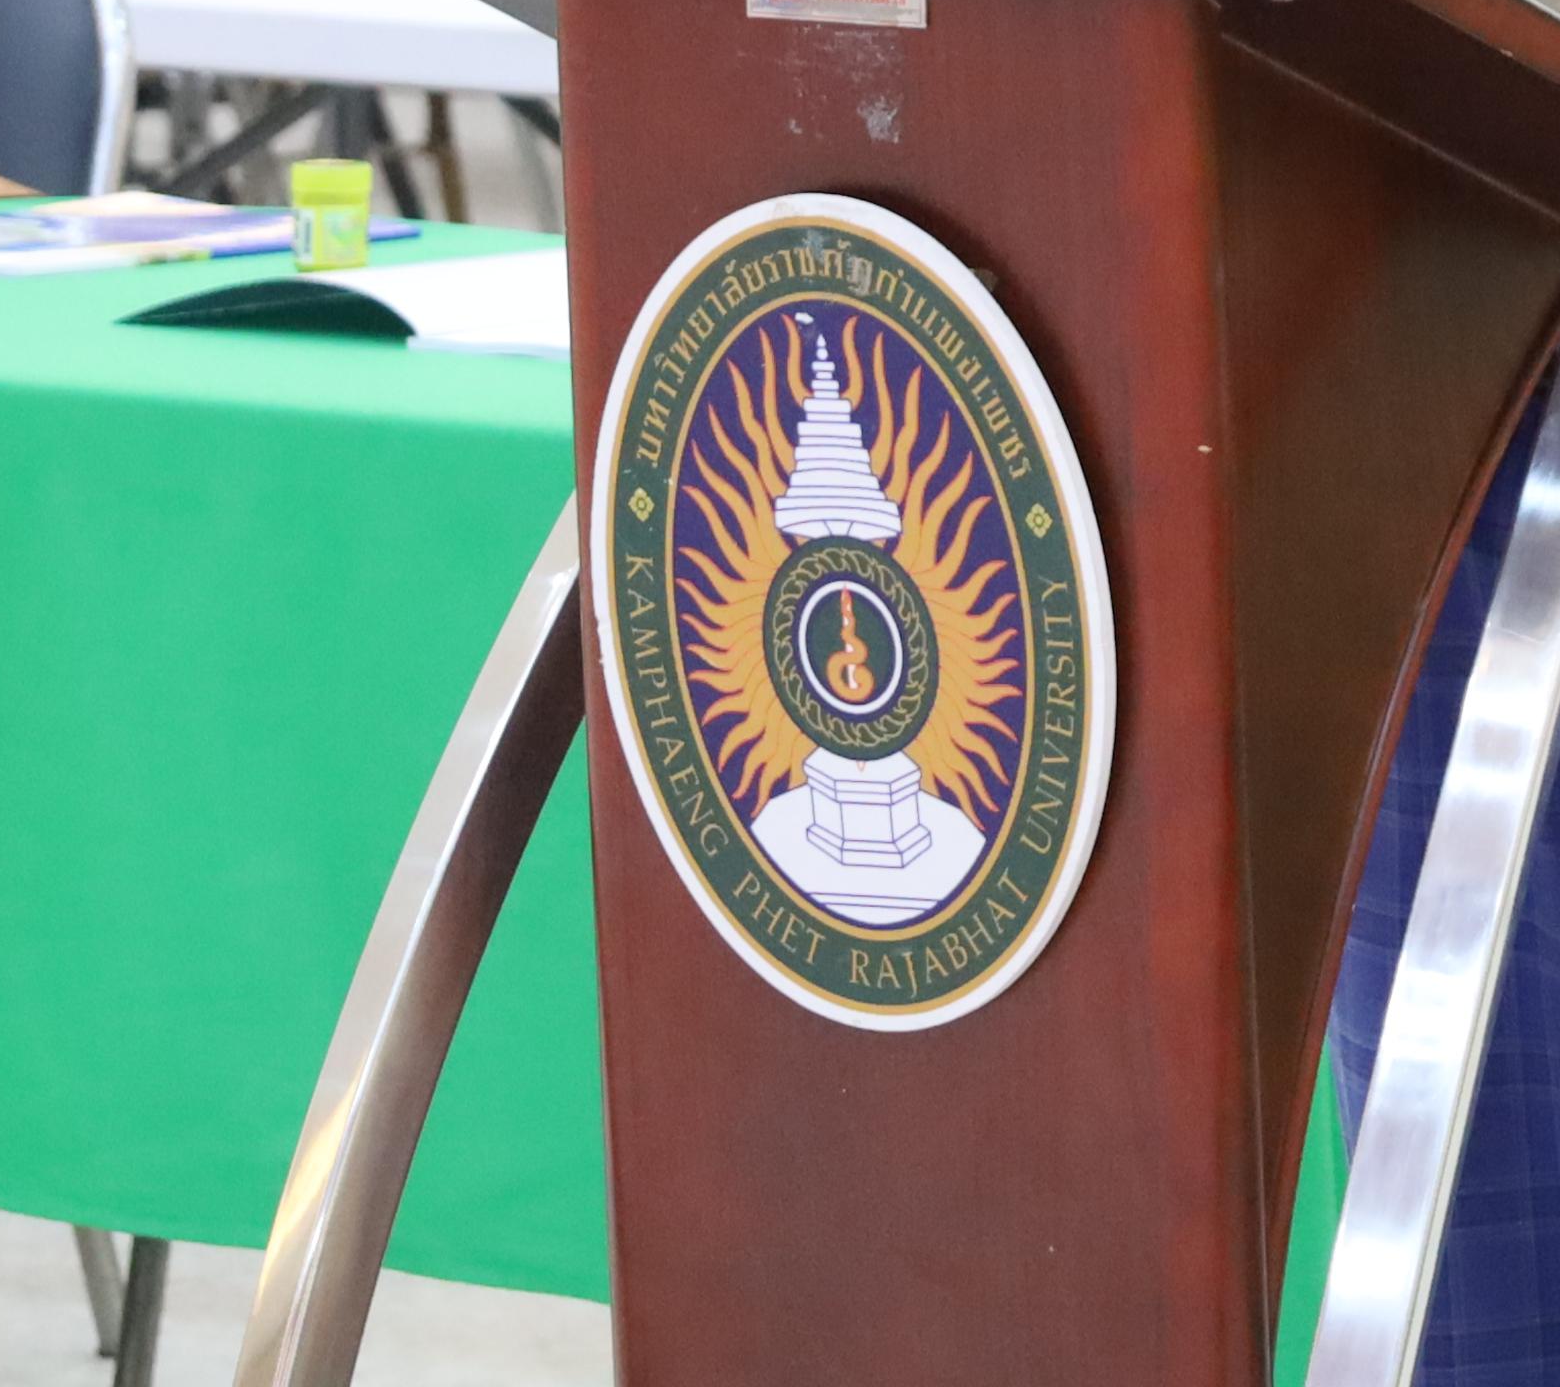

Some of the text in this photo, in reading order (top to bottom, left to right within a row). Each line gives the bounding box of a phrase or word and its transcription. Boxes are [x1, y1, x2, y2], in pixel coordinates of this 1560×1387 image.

[624, 553, 1076, 999] KAMPHAENG PHET RAJABHAT UNIVERSITY
